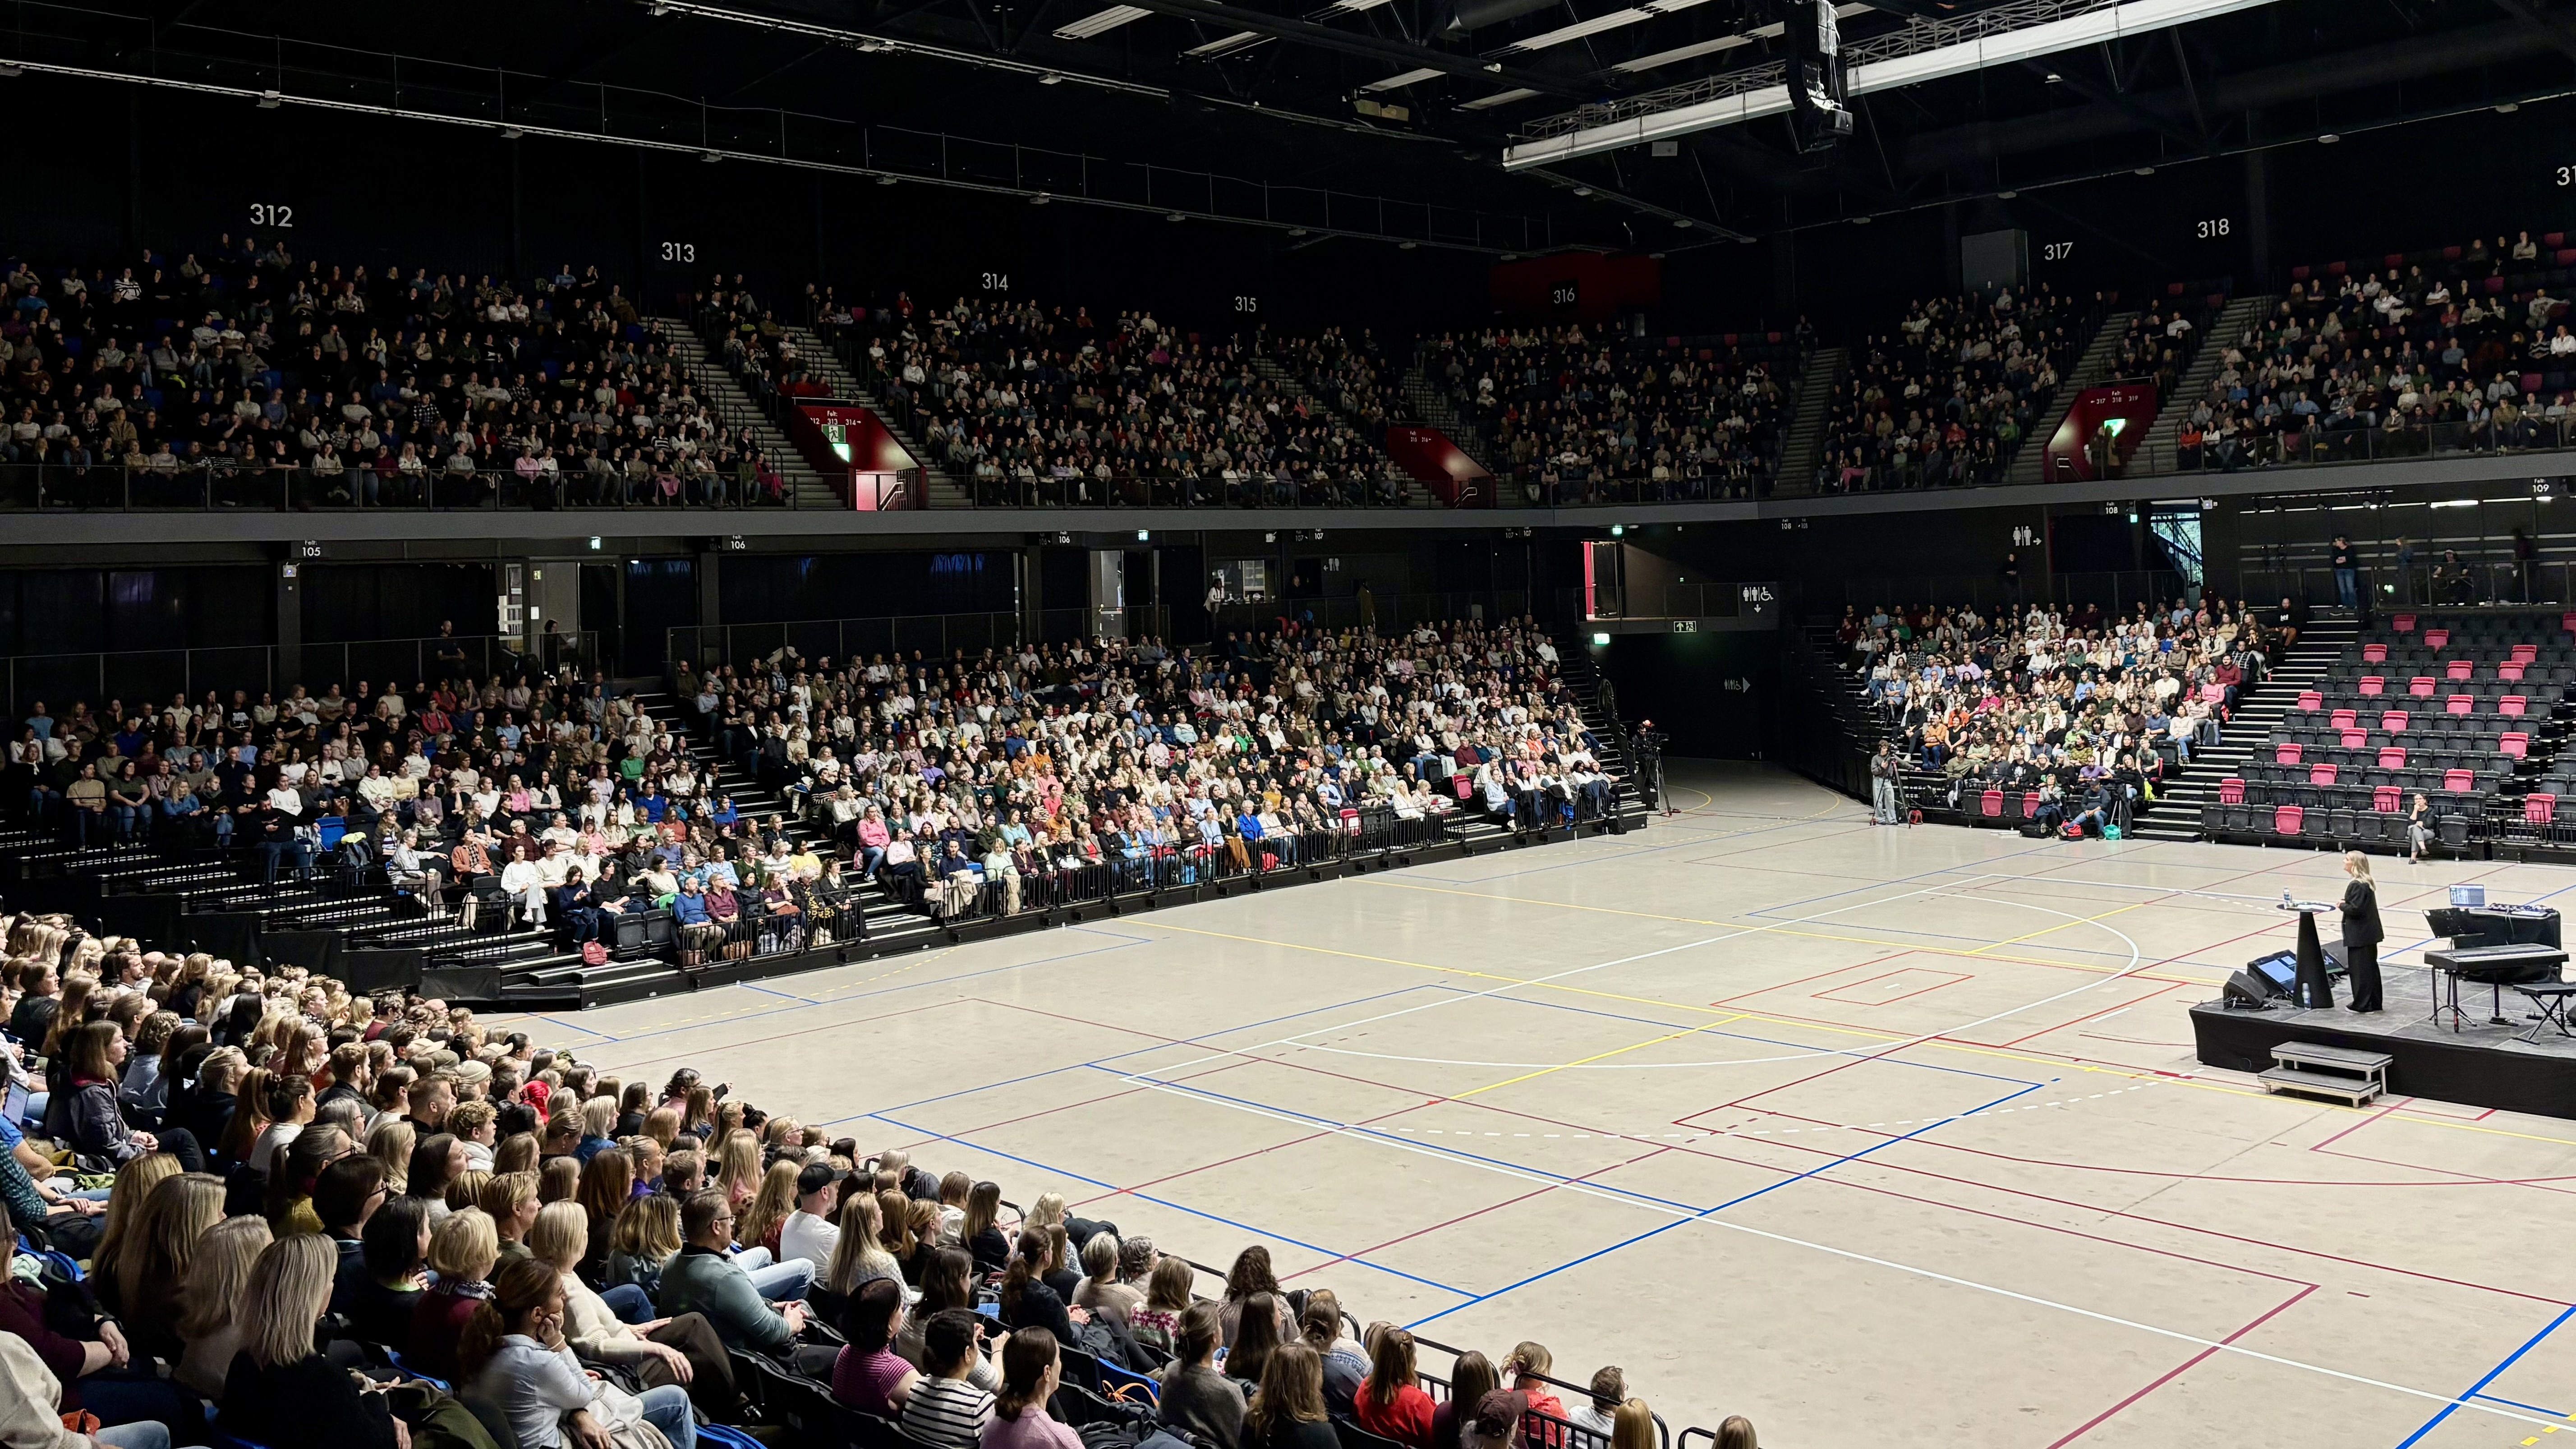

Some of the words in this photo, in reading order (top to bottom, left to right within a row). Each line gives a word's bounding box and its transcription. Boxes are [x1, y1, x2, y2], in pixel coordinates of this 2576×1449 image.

[250, 203, 293, 227] 312
[2198, 218, 2230, 238] 318
[662, 242, 695, 262] 313
[2045, 242, 2073, 260] 317
[982, 272, 1008, 291] 314
[1235, 296, 1256, 312] 315
[1554, 287, 1575, 304] 316
[2532, 484, 2549, 493] 109
[302, 547, 321, 556] 105
[731, 541, 745, 549] 106
